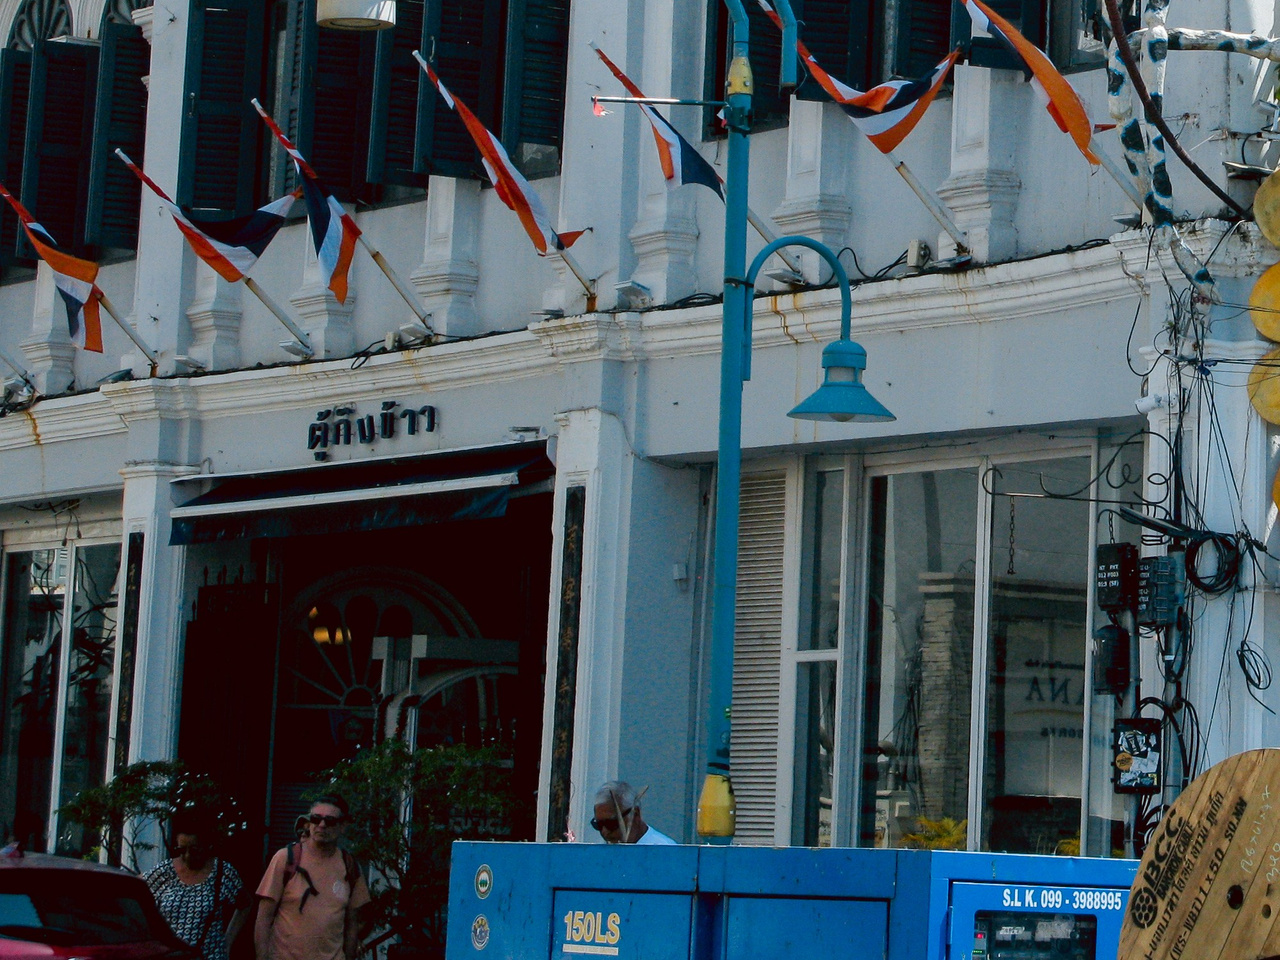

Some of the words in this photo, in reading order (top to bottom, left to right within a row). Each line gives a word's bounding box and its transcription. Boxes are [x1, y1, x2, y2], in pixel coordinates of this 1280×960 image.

[1142, 807, 1185, 889] BCC
[1155, 850, 1183, 900] BANGKOK
[1175, 820, 1196, 855] CABLE
[564, 911, 620, 944] 150LS
[1041, 890, 1062, 908] 099
[1073, 891, 1121, 910] 3988995
